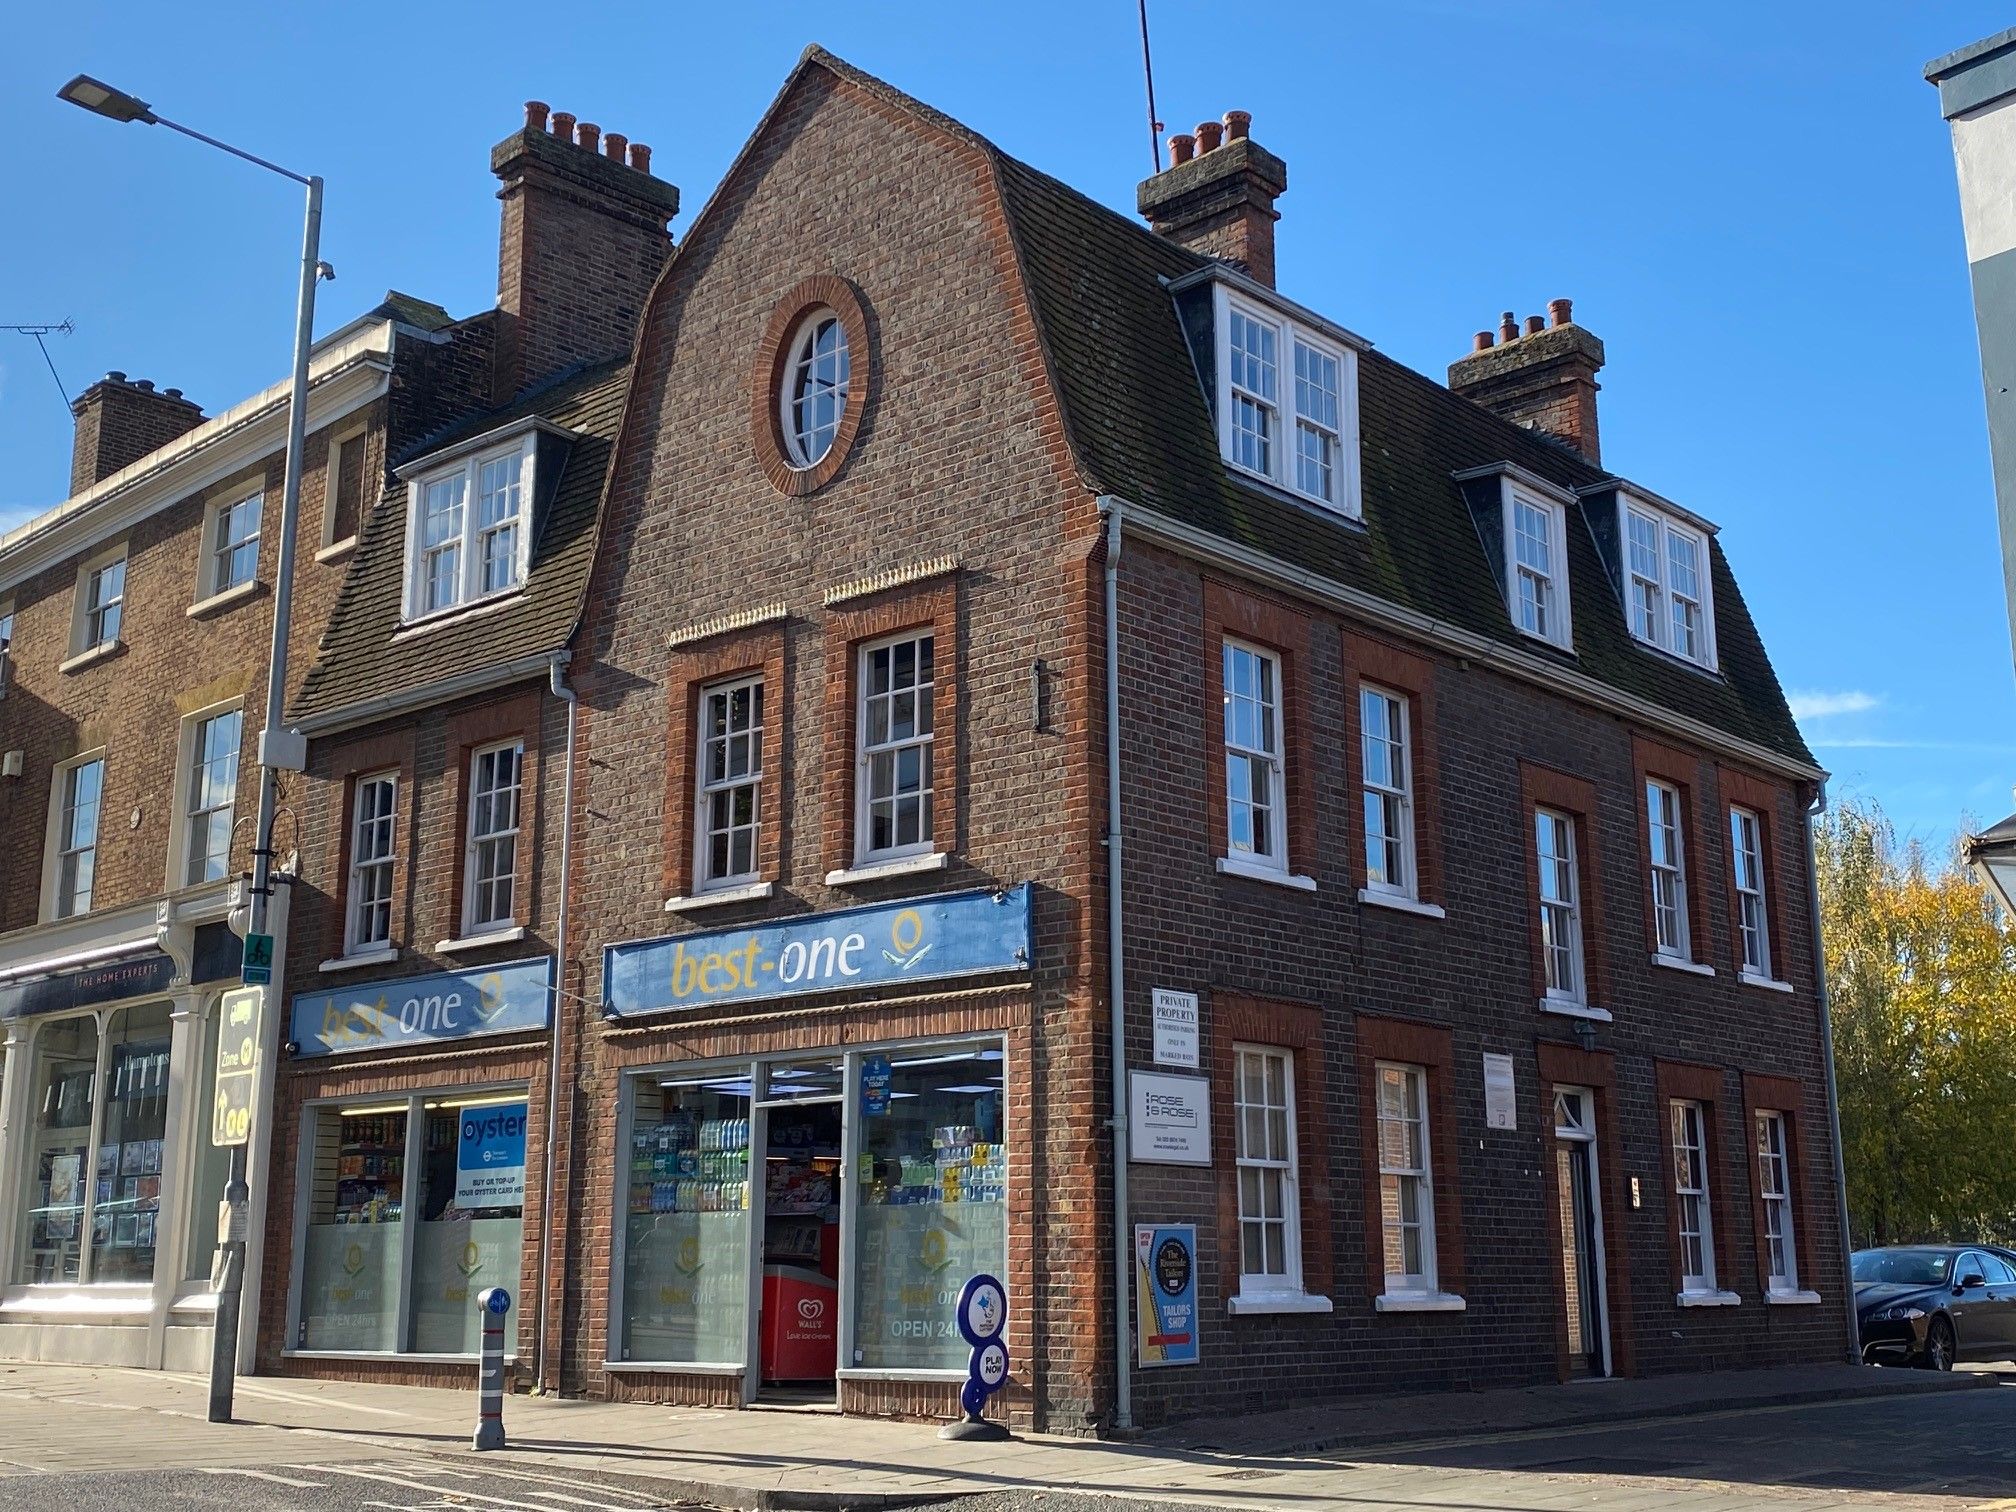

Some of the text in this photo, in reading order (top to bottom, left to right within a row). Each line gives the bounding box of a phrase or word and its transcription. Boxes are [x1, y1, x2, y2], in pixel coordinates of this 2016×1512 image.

[671, 933, 865, 998] best-one
[79, 964, 158, 988] THE HOME EXPERTS
[1160, 995, 1191, 1009] PRIVATE
[1156, 1006, 1195, 1022] PROPERTY
[221, 1051, 239, 1068] Zone
[1150, 1095, 1183, 1106] ROSE
[1161, 1106, 1194, 1118] ROSE
[463, 1112, 526, 1146] oyster
[473, 1176, 516, 1187] BUY OR TOP-UP
[458, 1188, 474, 1197] YOUR
[474, 1188, 497, 1197] OYSTER
[498, 1186, 513, 1195] CARD
[1167, 1249, 1179, 1259] The
[1162, 1304, 1191, 1316] TAILORS
[798, 1319, 823, 1330] WALL'S
[1168, 1317, 1187, 1328] SHOP
[891, 1321, 933, 1338] OPEN
[985, 1356, 1003, 1366] PLAY
[985, 1365, 1002, 1374] NOW
